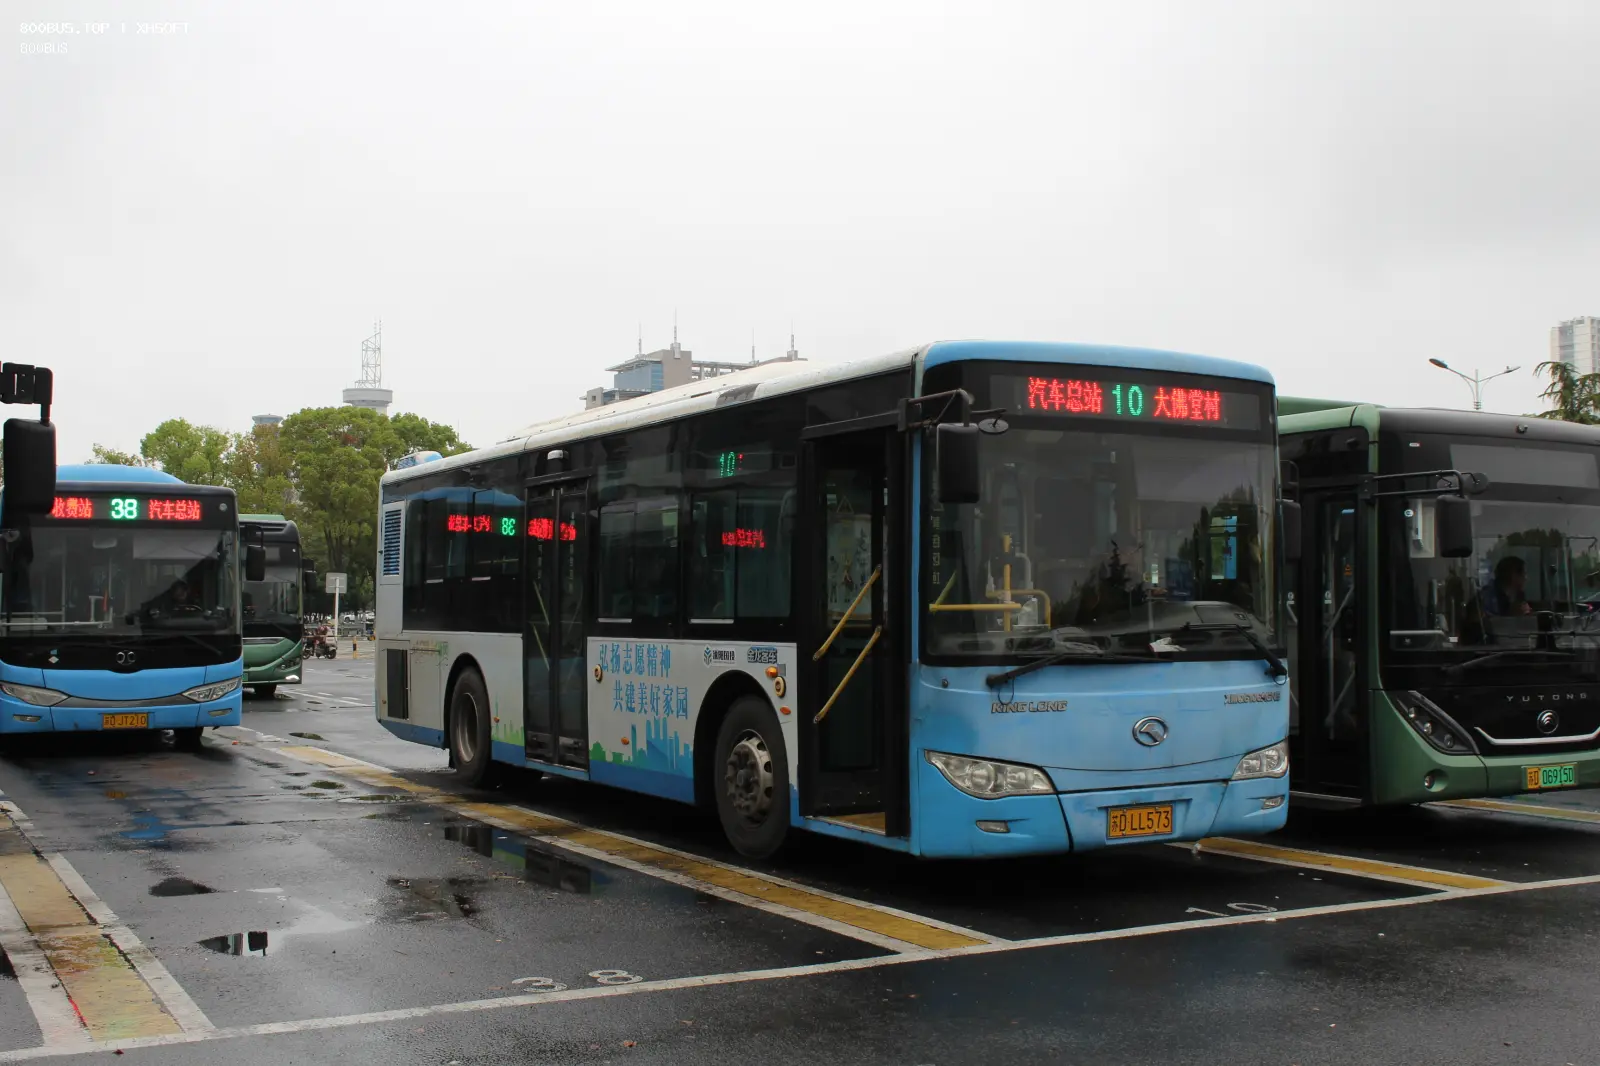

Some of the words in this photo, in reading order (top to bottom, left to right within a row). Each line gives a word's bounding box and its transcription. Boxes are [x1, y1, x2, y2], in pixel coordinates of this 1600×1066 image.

[1028, 376, 1102, 413] 汽车总站
[1112, 384, 1143, 416] 10
[111, 499, 138, 519] 38
[148, 500, 201, 520] 汽车总站
[600, 643, 671, 678] 弘扬志愿精神
[612, 679, 688, 719] 共建美好家园
[991, 702, 1028, 715] KING
[1029, 701, 1068, 713] LONG
[1506, 692, 1587, 702] YUTONG
[1184, 902, 1278, 917] 10
[511, 969, 643, 994] 38
